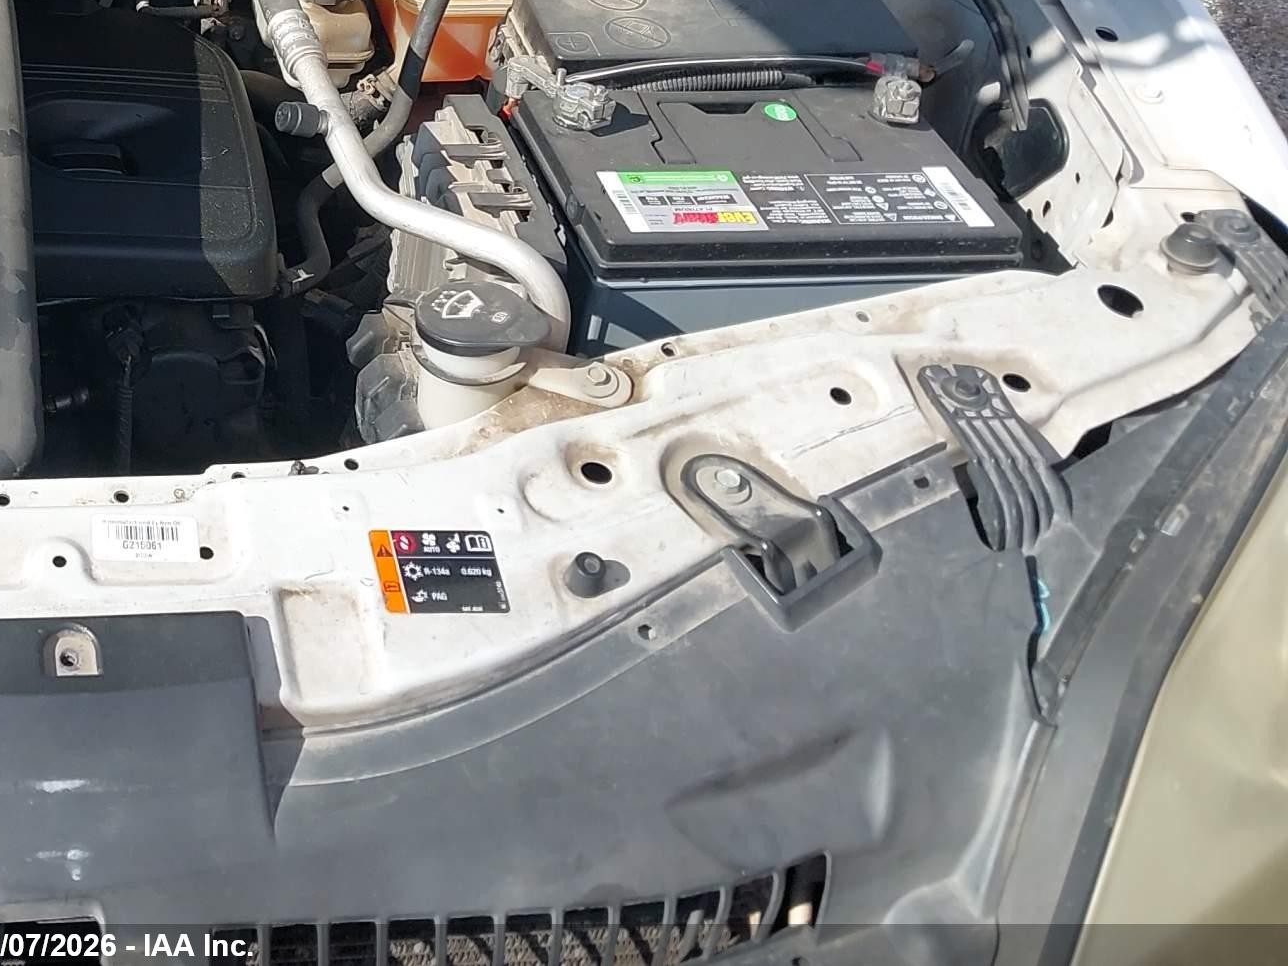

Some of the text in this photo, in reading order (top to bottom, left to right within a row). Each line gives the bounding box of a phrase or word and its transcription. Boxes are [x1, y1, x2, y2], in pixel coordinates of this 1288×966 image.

[423, 545, 441, 553] AUTO
[423, 566, 451, 575] R-134a
[431, 591, 448, 601] PAG
